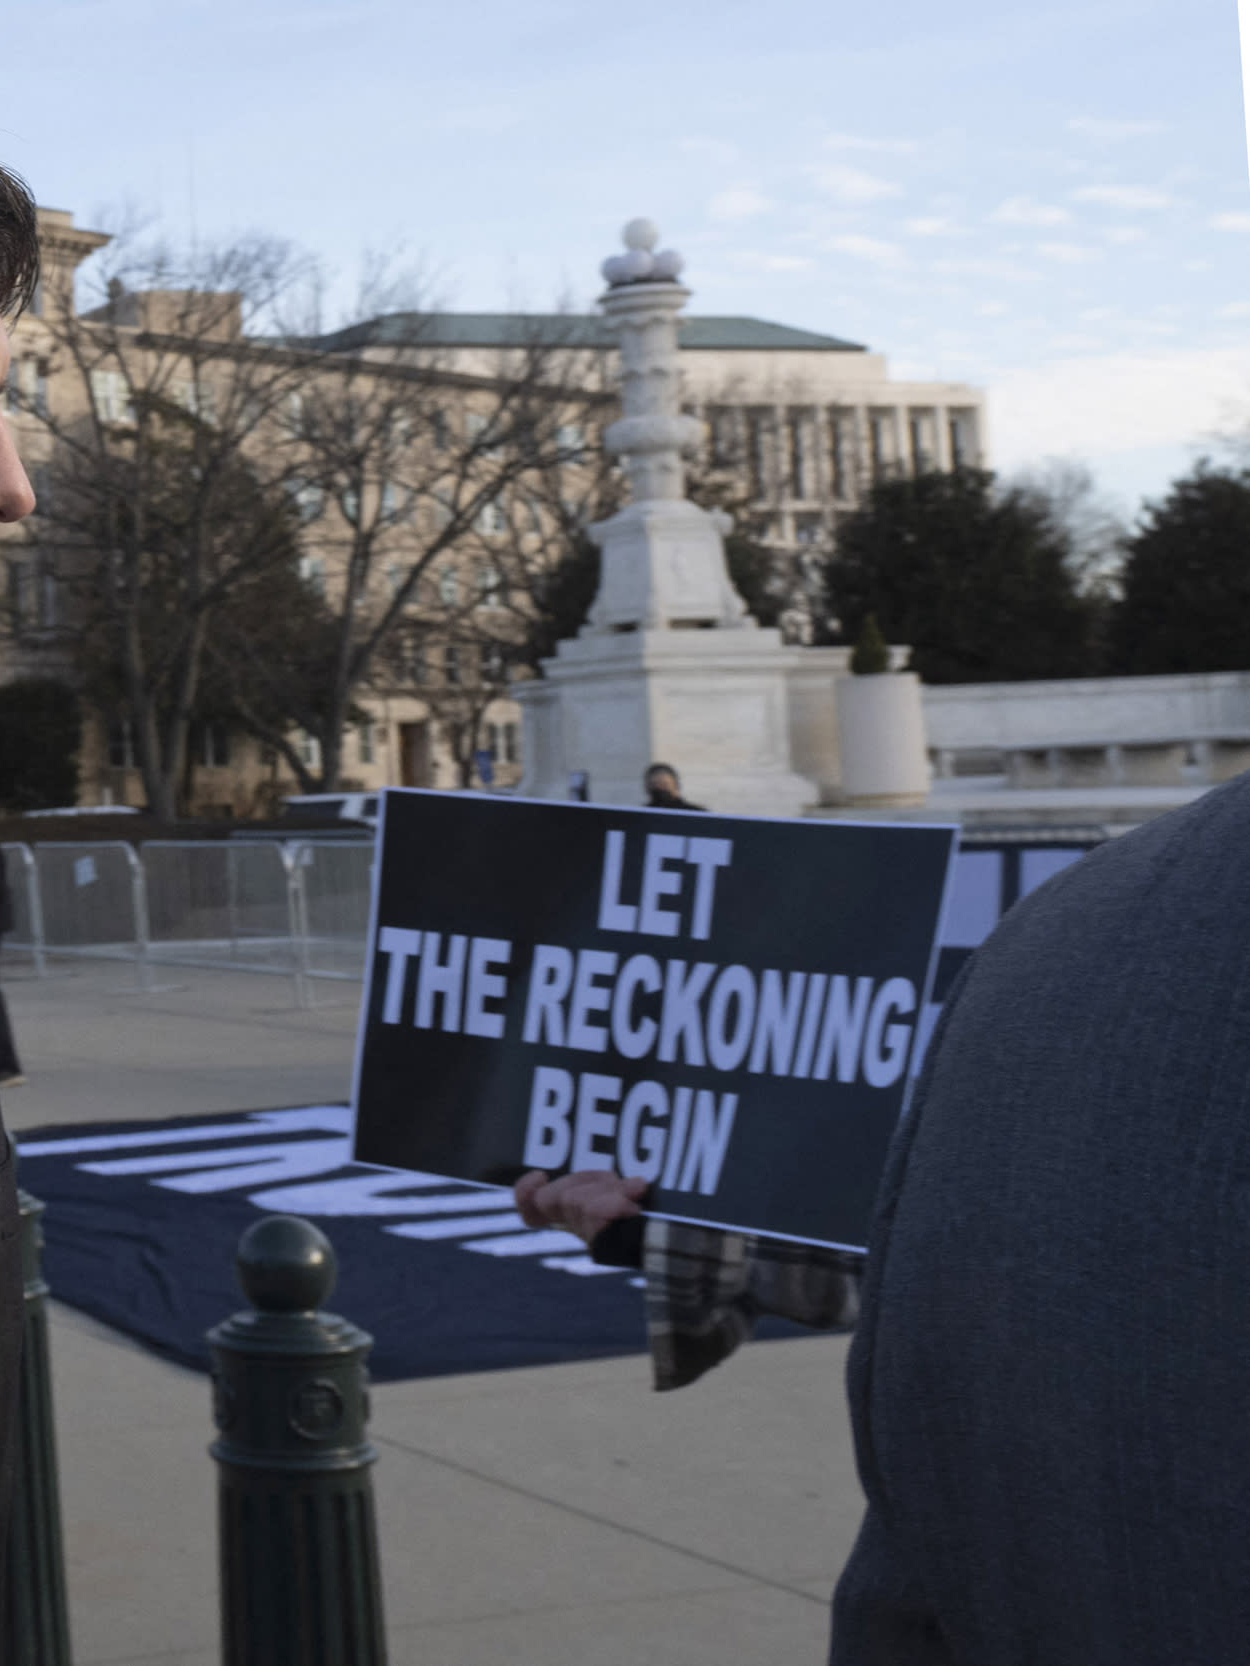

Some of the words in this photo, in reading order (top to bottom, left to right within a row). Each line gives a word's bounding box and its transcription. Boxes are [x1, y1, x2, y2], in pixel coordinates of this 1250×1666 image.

[598, 831, 733, 940] LET
[379, 927, 511, 1039] THE
[523, 945, 916, 1087] RECKONING
[524, 1066, 738, 1195] BEGIN
